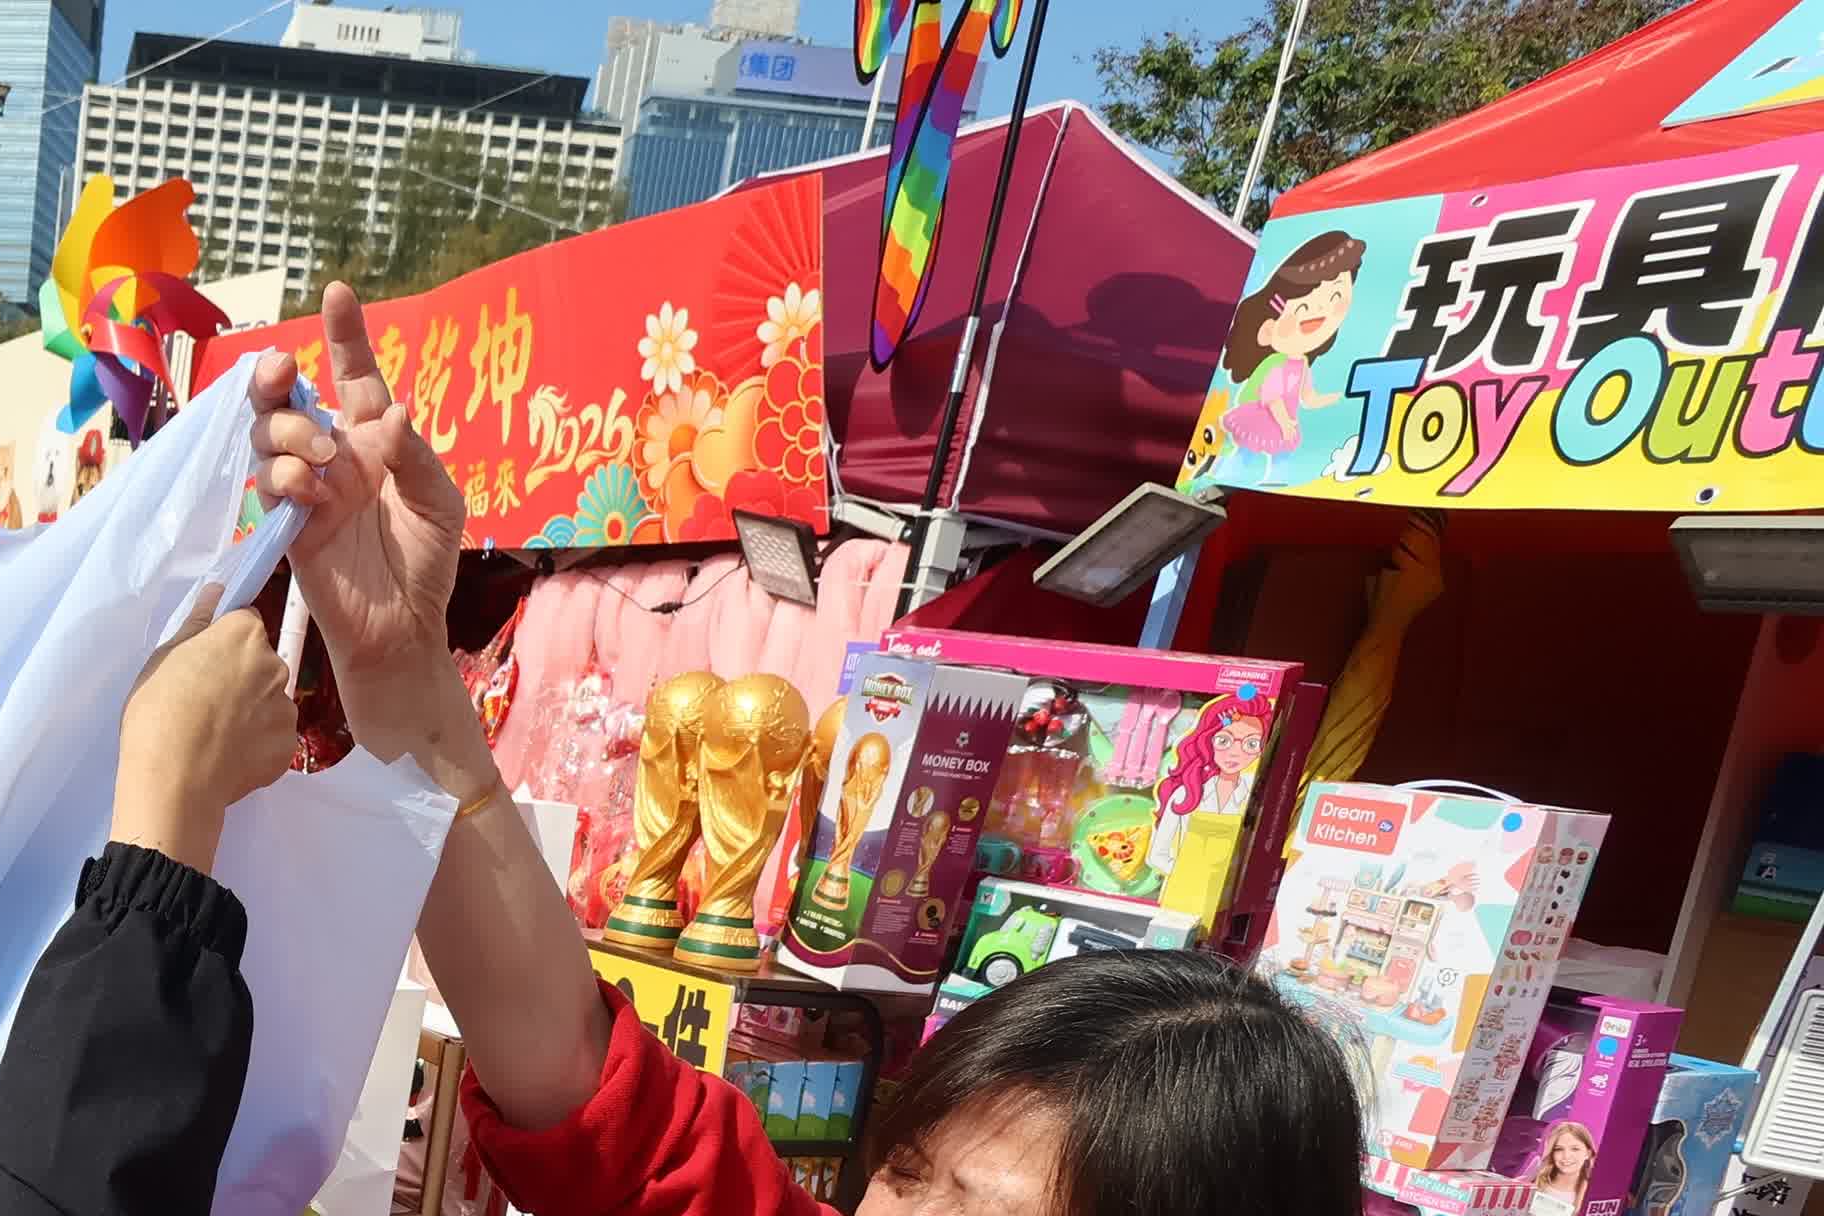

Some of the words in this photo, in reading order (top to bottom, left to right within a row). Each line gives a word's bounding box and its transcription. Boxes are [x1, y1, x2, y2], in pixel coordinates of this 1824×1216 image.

[738, 52, 794, 81] 集团
[524, 382, 637, 497] 2026
[1346, 356, 1550, 498] Toy
[884, 632, 913, 655] Tea
[916, 639, 943, 658] set
[863, 677, 893, 697] MONEY
[893, 684, 914, 705] BOX
[921, 752, 964, 771] MONEY
[965, 758, 991, 774] BOX
[1321, 800, 1377, 824] Dream
[1314, 823, 1378, 847] Kitchen
[1588, 1202, 1617, 1214] BUN
